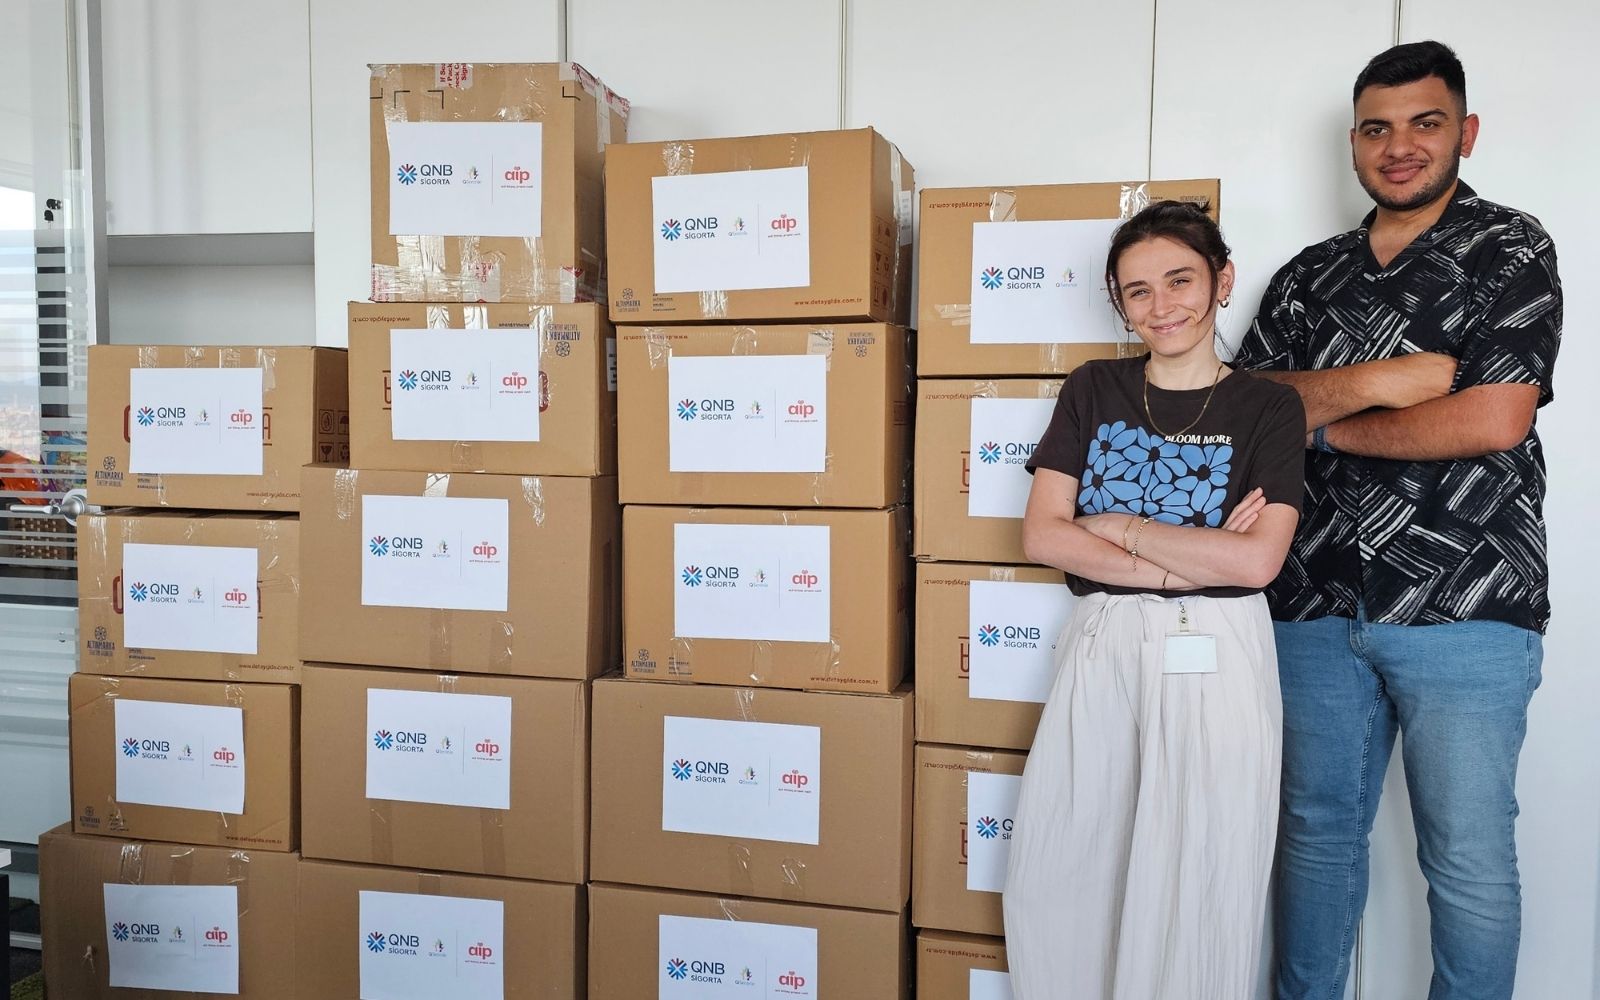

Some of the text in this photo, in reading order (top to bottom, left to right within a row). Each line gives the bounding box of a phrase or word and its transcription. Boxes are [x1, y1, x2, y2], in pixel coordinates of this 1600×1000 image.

[421, 164, 452, 176] QNB
[685, 217, 718, 230] QNB
[1008, 267, 1044, 280] QNB
[421, 370, 451, 382] QNB
[701, 400, 734, 411] QNB
[157, 407, 185, 418] QNB
[1165, 434, 1232, 445] BLOOM MORE
[392, 537, 423, 549] QNB
[706, 567, 739, 579] QNB
[150, 584, 179, 595] QNB
[1004, 626, 1040, 639] QNB
[396, 732, 426, 744] QNB
[142, 740, 169, 752] QNB
[696, 761, 729, 775] QNB
[131, 924, 159, 935] QNB
[389, 934, 419, 947] QNB
[691, 961, 725, 975] QNB
